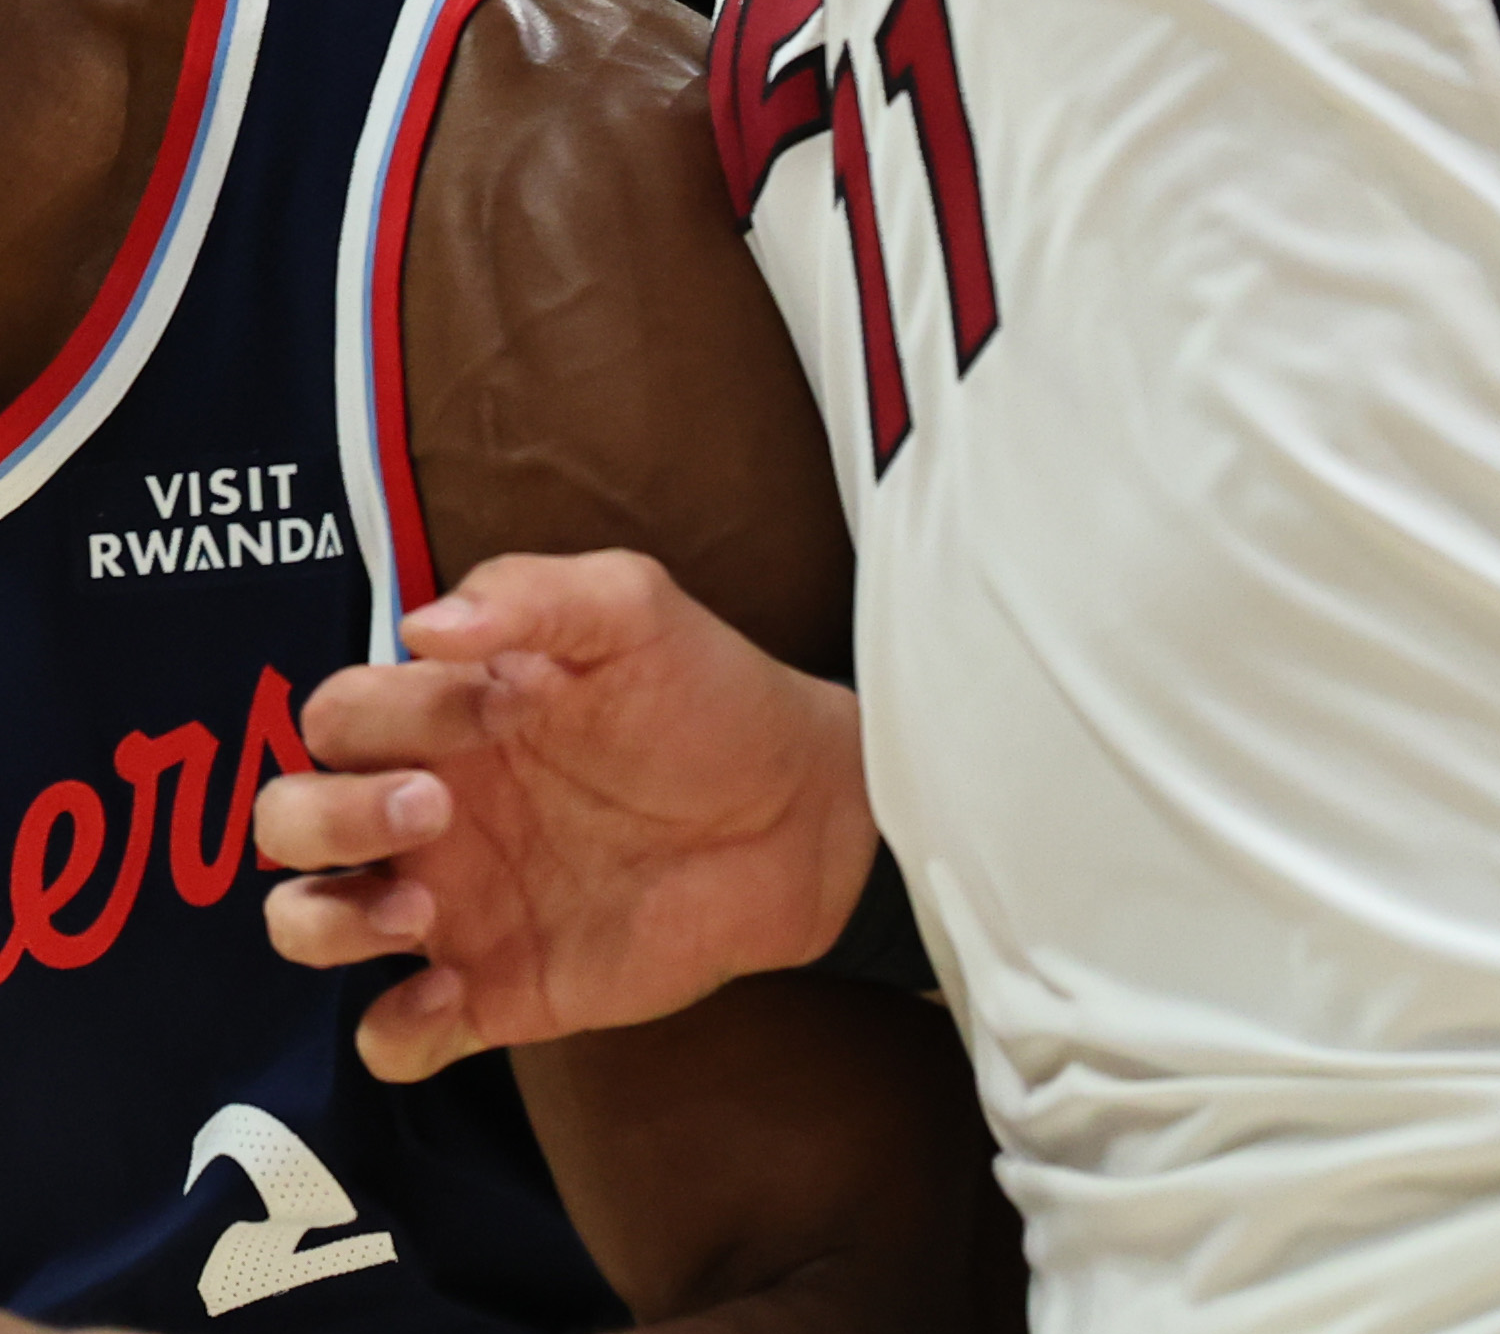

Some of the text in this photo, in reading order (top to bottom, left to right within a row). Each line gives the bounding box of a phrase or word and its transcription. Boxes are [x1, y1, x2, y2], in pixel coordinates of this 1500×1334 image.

[144, 463, 298, 519] VISIT
[88, 512, 344, 579] RWANDA
[183, 1102, 397, 1317] 2
